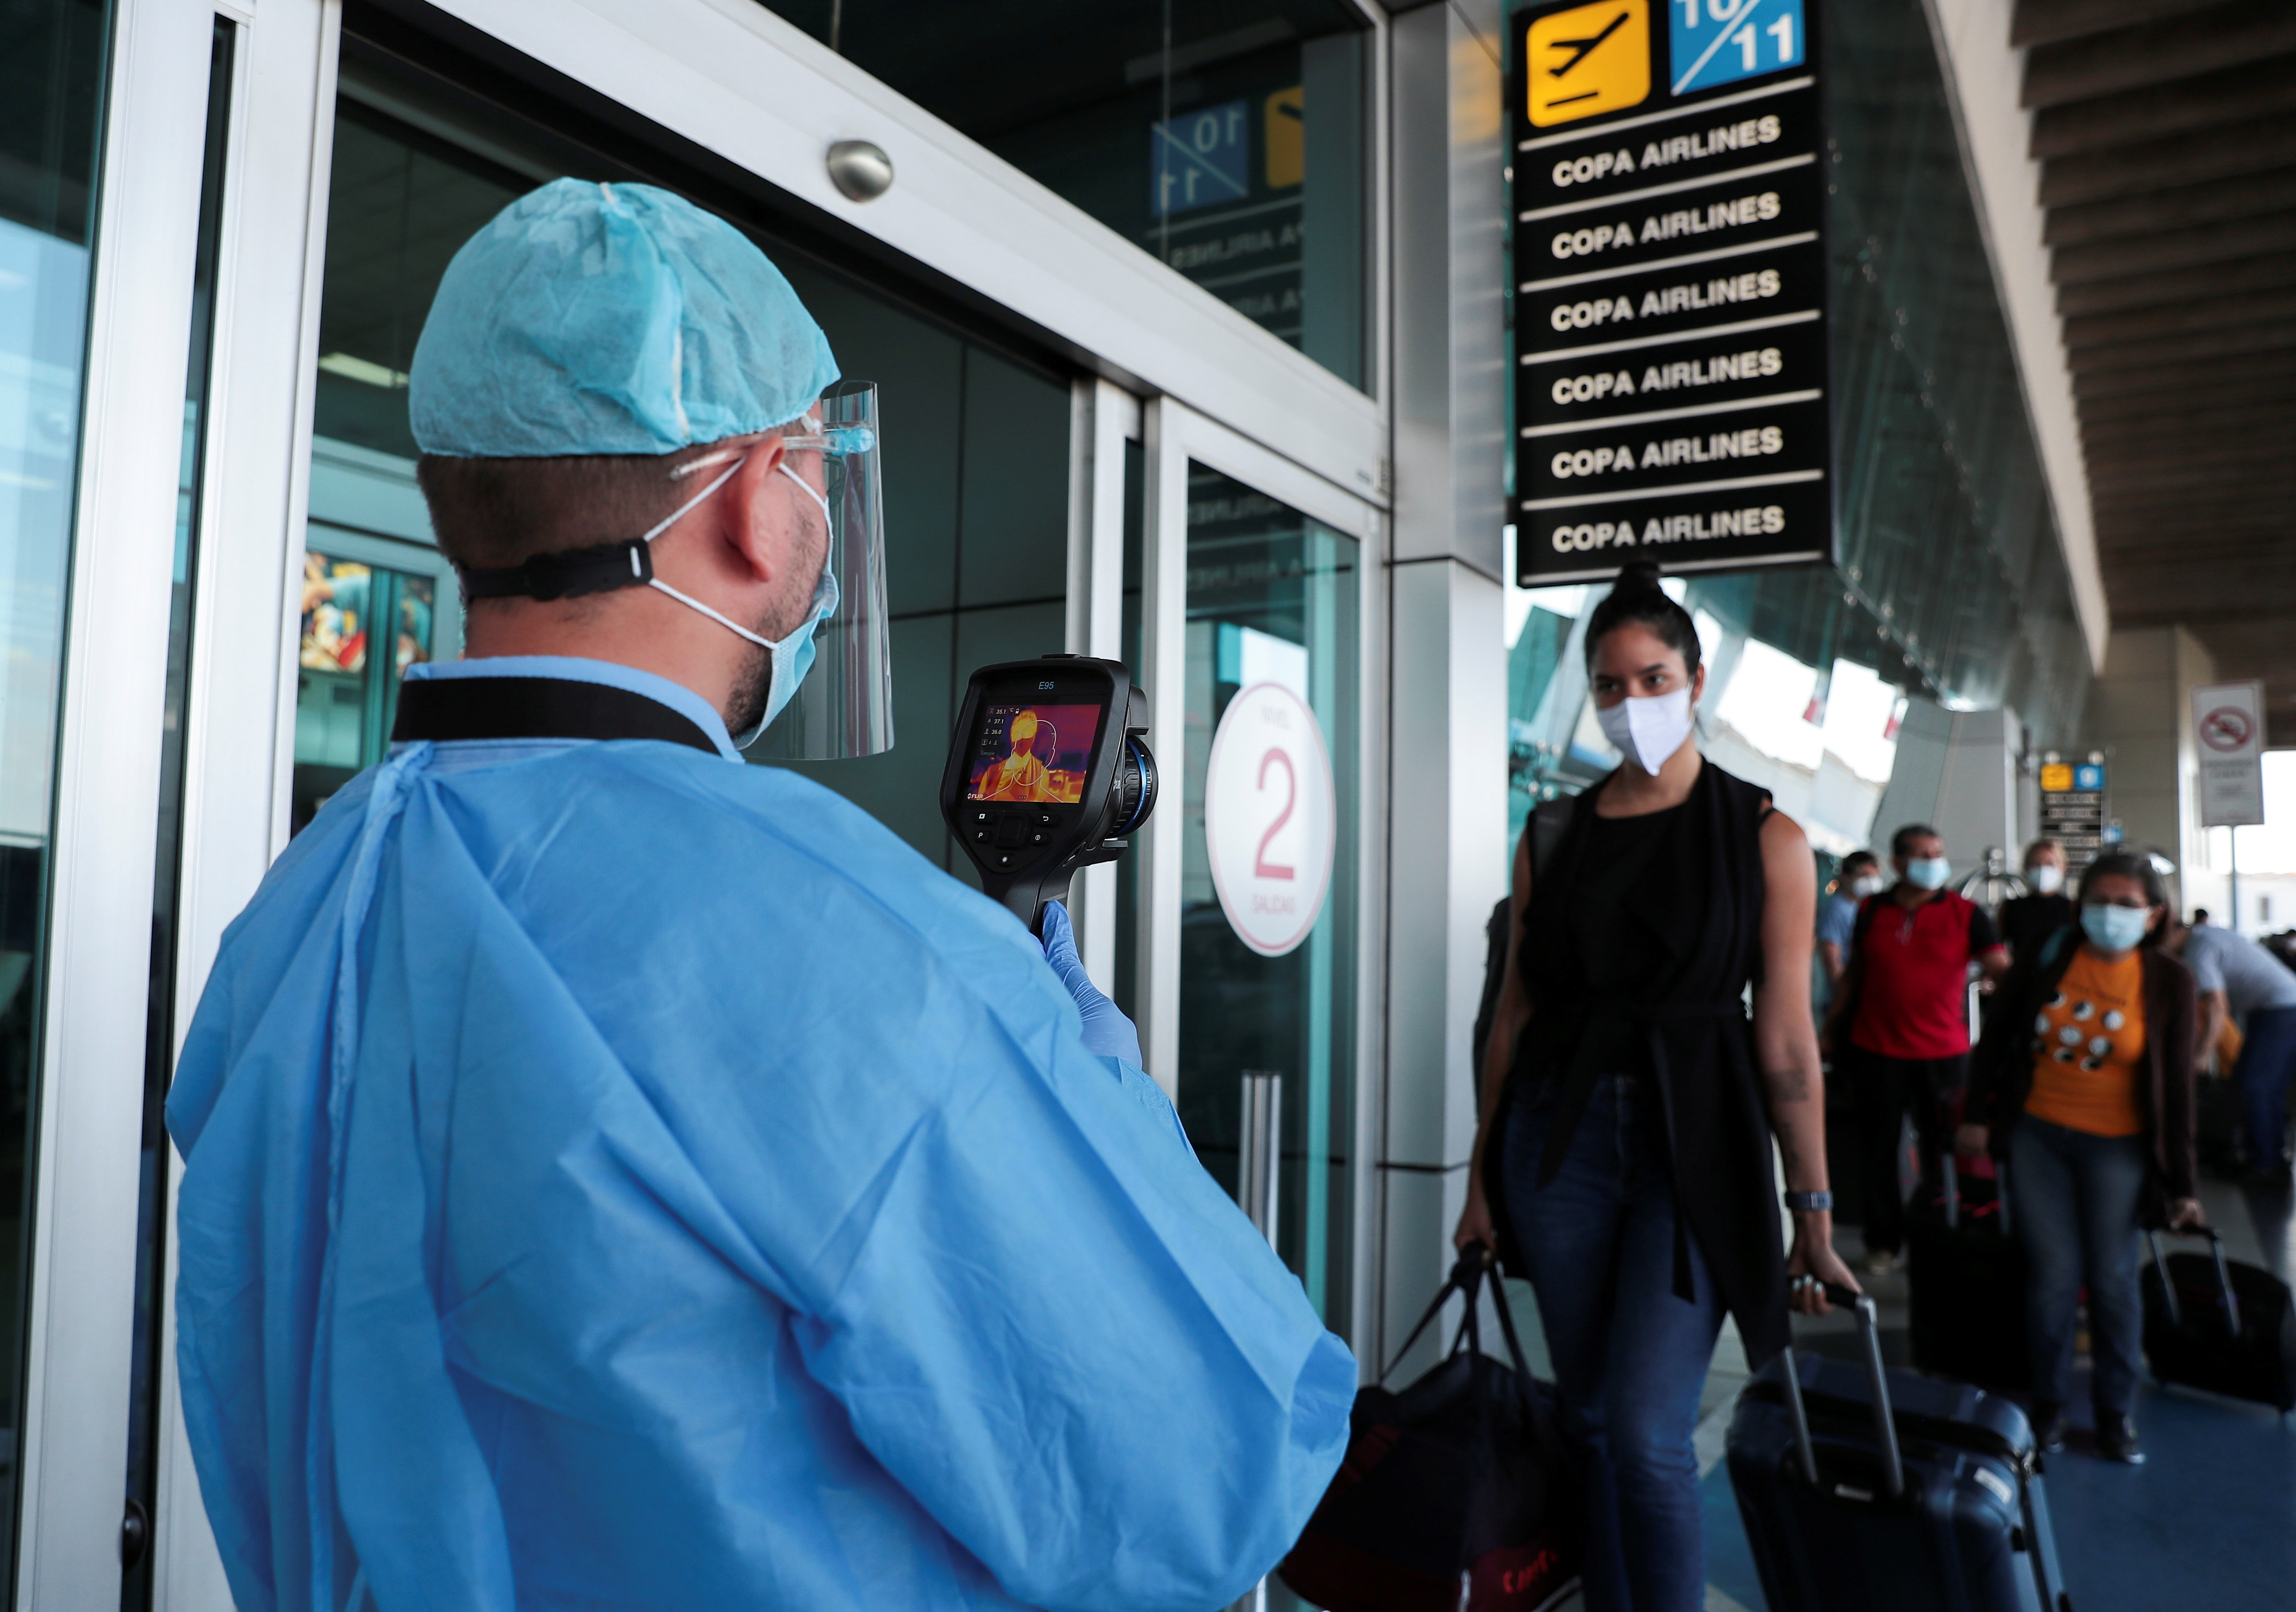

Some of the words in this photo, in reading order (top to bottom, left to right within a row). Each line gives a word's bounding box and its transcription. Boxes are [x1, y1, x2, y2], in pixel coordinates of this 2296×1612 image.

[1731, 13, 1794, 71] 11
[1552, 150, 1634, 186] COPA
[1641, 115, 1780, 168] AIRLINES
[1552, 223, 1633, 259] COPA
[1641, 192, 1780, 242] AIRLINES
[1551, 297, 1633, 331] COPA
[1641, 270, 1780, 316] AIRLINES
[1552, 371, 1634, 404] COPA
[1642, 348, 1781, 392] AIRLINES
[1552, 447, 1634, 478] COPA
[1642, 427, 1782, 468] AIRLINES
[1552, 522, 1635, 552] COPA
[1643, 506, 1784, 543] AIRLINES
[1254, 746, 1295, 880] 2
